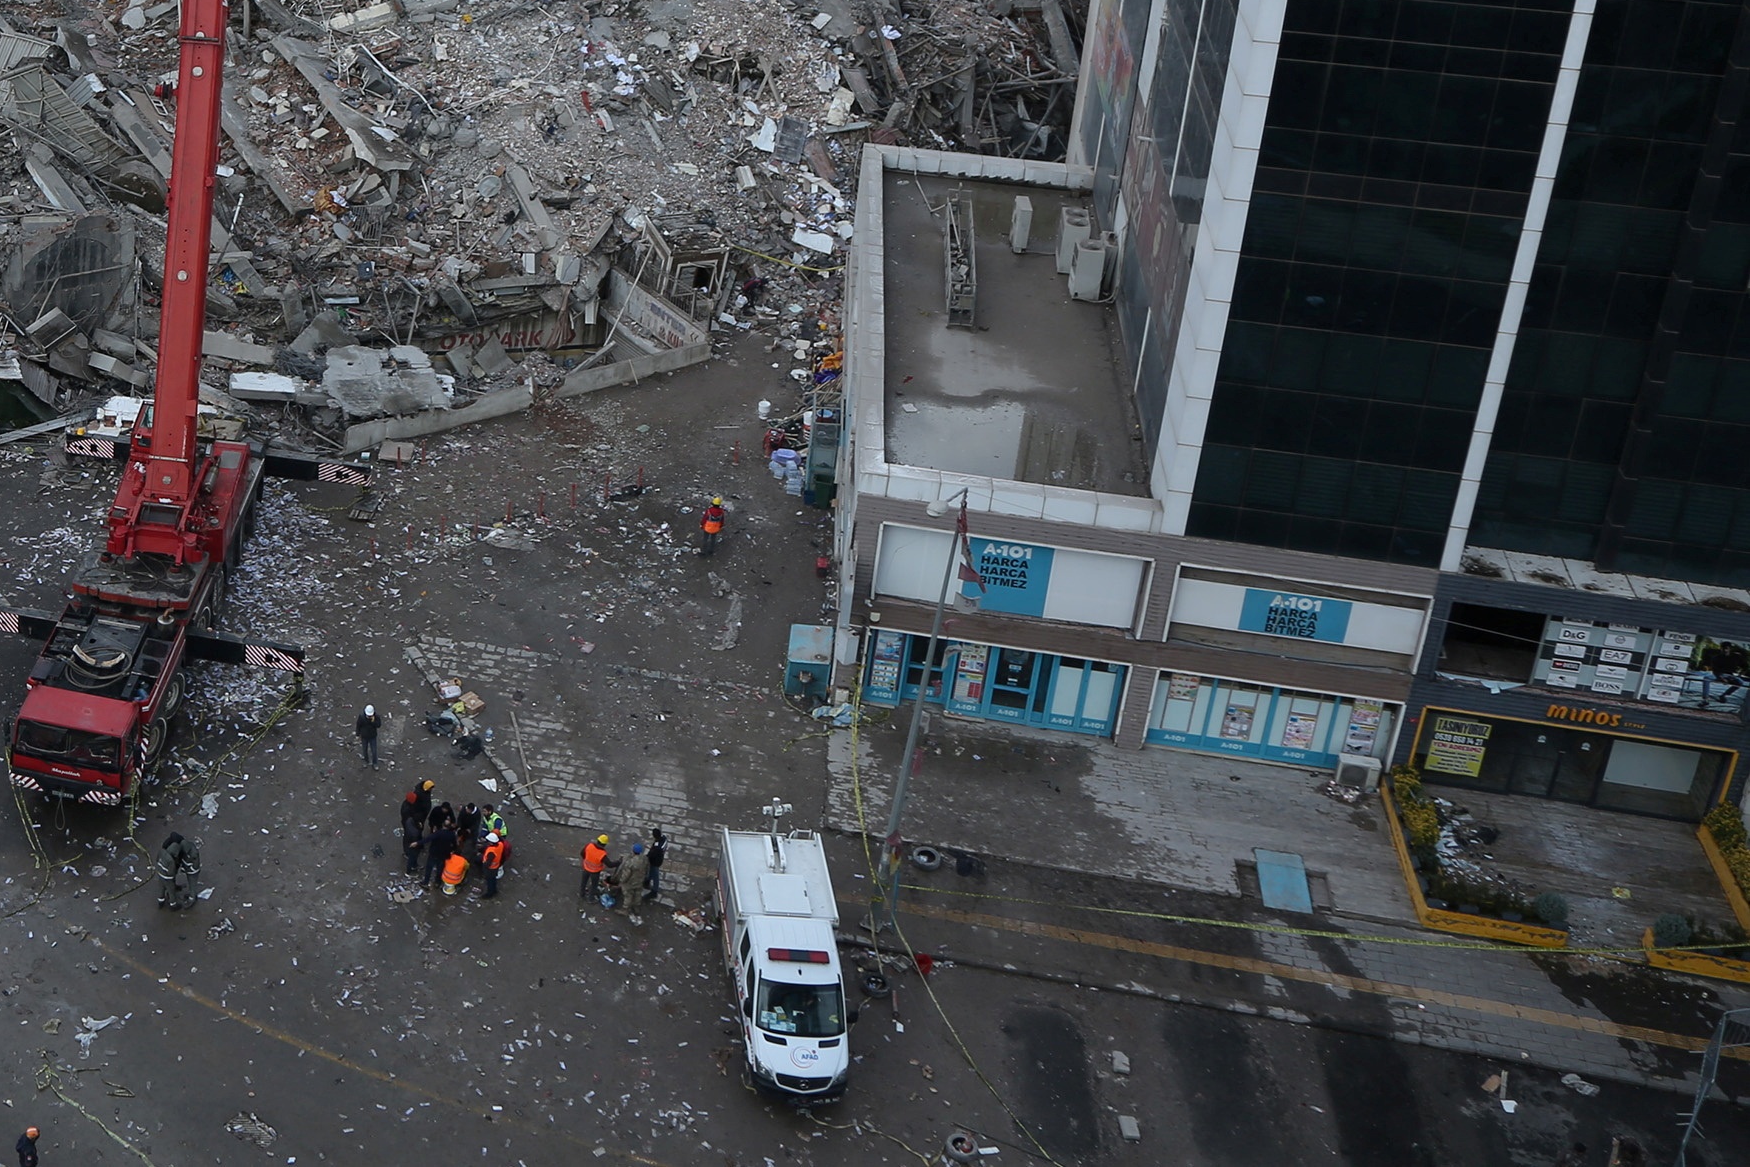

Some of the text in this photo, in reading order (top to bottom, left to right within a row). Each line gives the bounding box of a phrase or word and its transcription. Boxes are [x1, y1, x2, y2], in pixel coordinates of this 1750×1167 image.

[981, 555, 1029, 570] HARCA
[980, 565, 1027, 579] HARCA
[1268, 606, 1318, 622] HARCA
[1266, 615, 1316, 630] HARCA
[1563, 629, 1586, 640] D&G
[1604, 650, 1629, 661] EA7
[1594, 681, 1620, 691] BOSS
